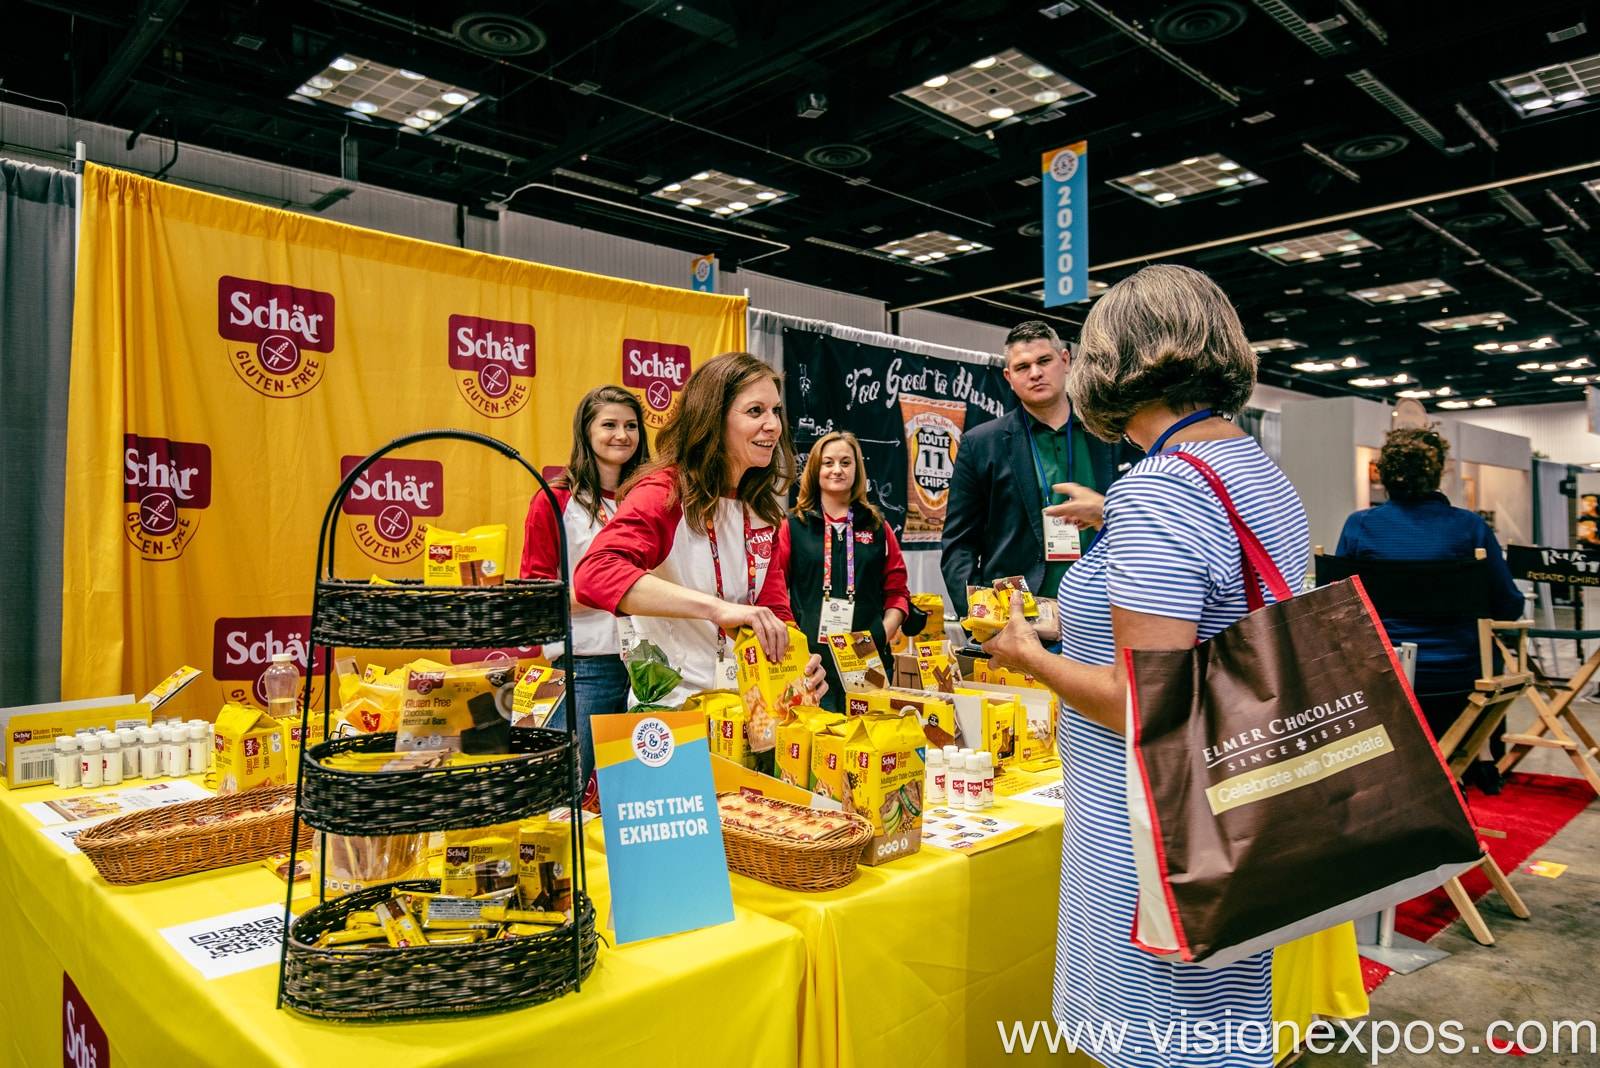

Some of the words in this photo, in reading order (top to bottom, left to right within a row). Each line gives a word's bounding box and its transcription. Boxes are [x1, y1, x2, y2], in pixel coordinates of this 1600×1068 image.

[1057, 186, 1073, 296] 20200
[230, 291, 323, 343] Schär
[457, 327, 530, 369] Schär
[236, 350, 319, 392] GLUTEN-FREE
[629, 349, 685, 386] Schär
[846, 367, 880, 411] Too
[886, 358, 934, 409] Good
[932, 370, 948, 395] to
[463, 378, 526, 413] GLUTEN-FREE
[918, 432, 950, 447] ROUTE
[922, 449, 945, 470] 11
[918, 469, 951, 477] POTATO
[350, 469, 434, 510] Schär
[919, 476, 949, 488] CHIPS
[356, 523, 428, 558] GLUTEN-FREE
[454, 545, 477, 553] Gluten
[454, 553, 470, 561] Free
[779, 665, 797, 673] Crackers
[405, 699, 431, 708] Gluten
[433, 697, 452, 708] Free
[851, 702, 868, 712] Schär
[432, 716, 447, 725] Bars
[1202, 728, 1267, 762] ELMER
[1228, 745, 1289, 771] SINCE
[1311, 719, 1356, 744] 1855
[881, 756, 896, 766] Schär
[897, 751, 911, 760] Gluten
[897, 760, 907, 768] Free
[1218, 769, 1293, 803] Celebrate
[1295, 760, 1322, 779] with
[1323, 734, 1385, 768] Chocolate
[908, 770, 923, 778] Crackers
[618, 799, 664, 821] FIRST
[667, 795, 705, 816] TIME
[619, 818, 709, 846] EXHIBITOR
[447, 848, 468, 857] Schär
[471, 846, 493, 854] Gluten
[471, 854, 486, 863] Free
